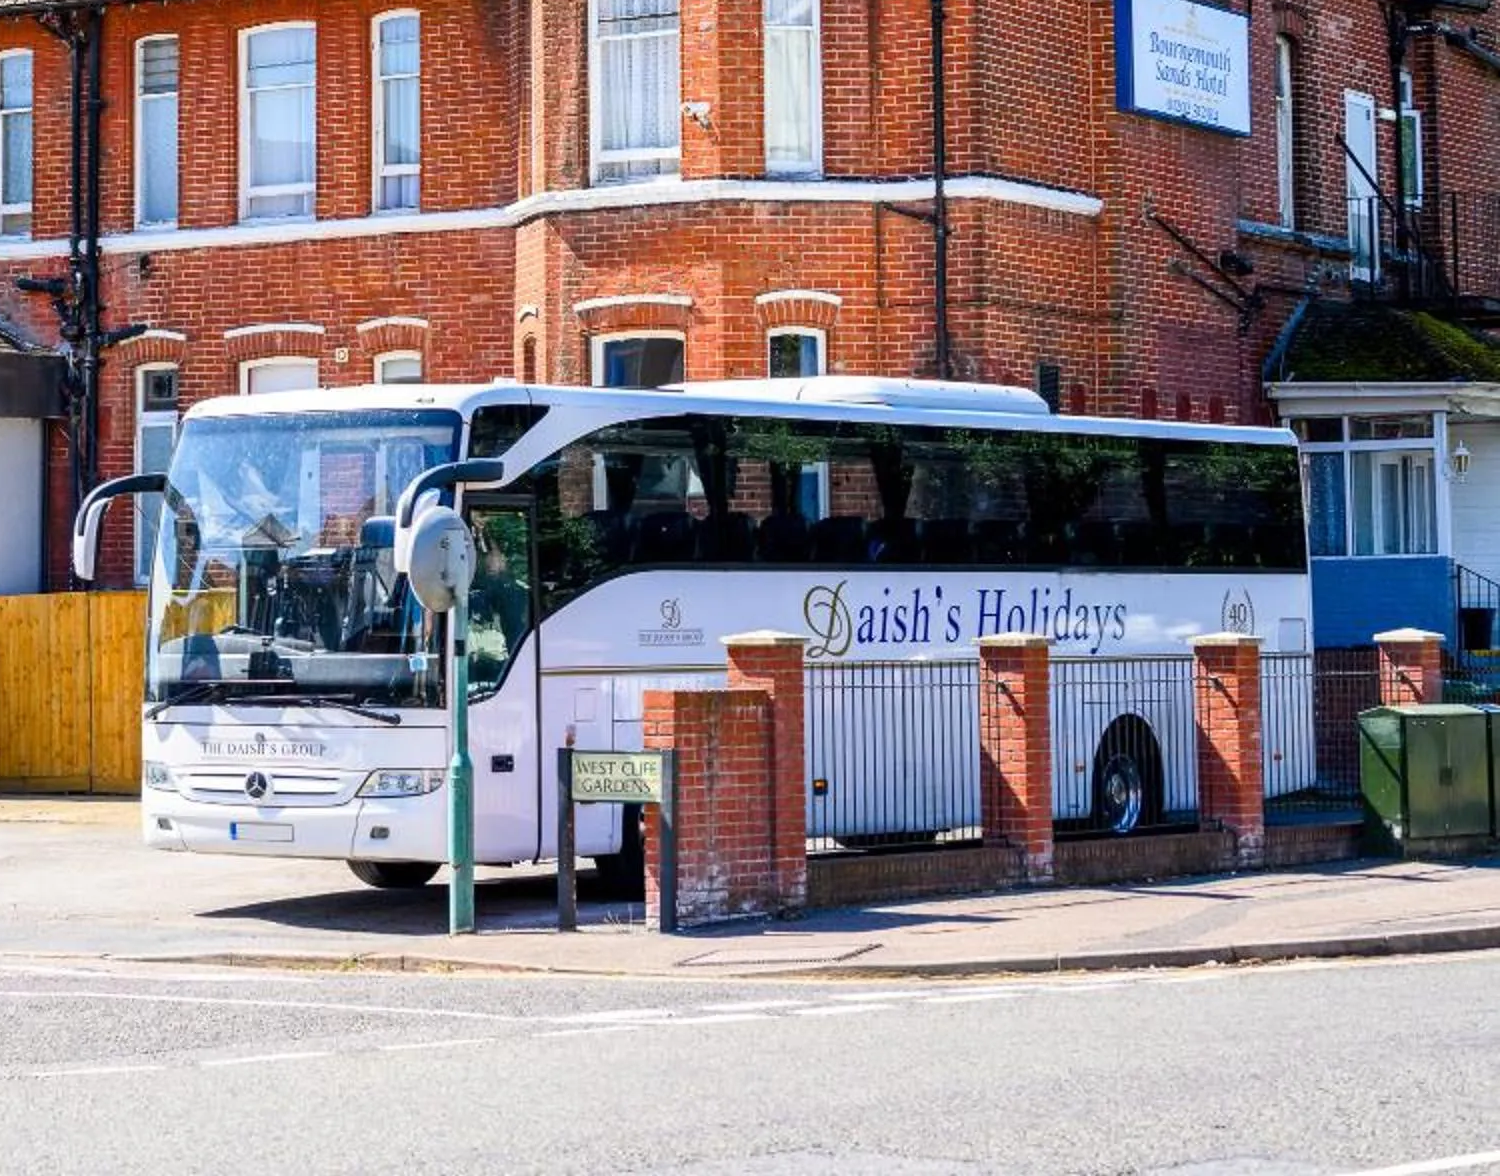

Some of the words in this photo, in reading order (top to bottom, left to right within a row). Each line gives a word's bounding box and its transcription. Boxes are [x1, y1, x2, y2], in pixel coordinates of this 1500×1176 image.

[1150, 31, 1231, 73] Bournemouth
[1156, 59, 1191, 87] Sands
[1194, 67, 1229, 96] Hotel
[803, 579, 961, 658] Daish's
[977, 587, 1127, 655] Holidays
[1229, 603, 1247, 624] 40
[576, 760, 616, 775] WEST
[621, 761, 657, 777] CLIFF
[581, 777, 651, 793] GARDENS
